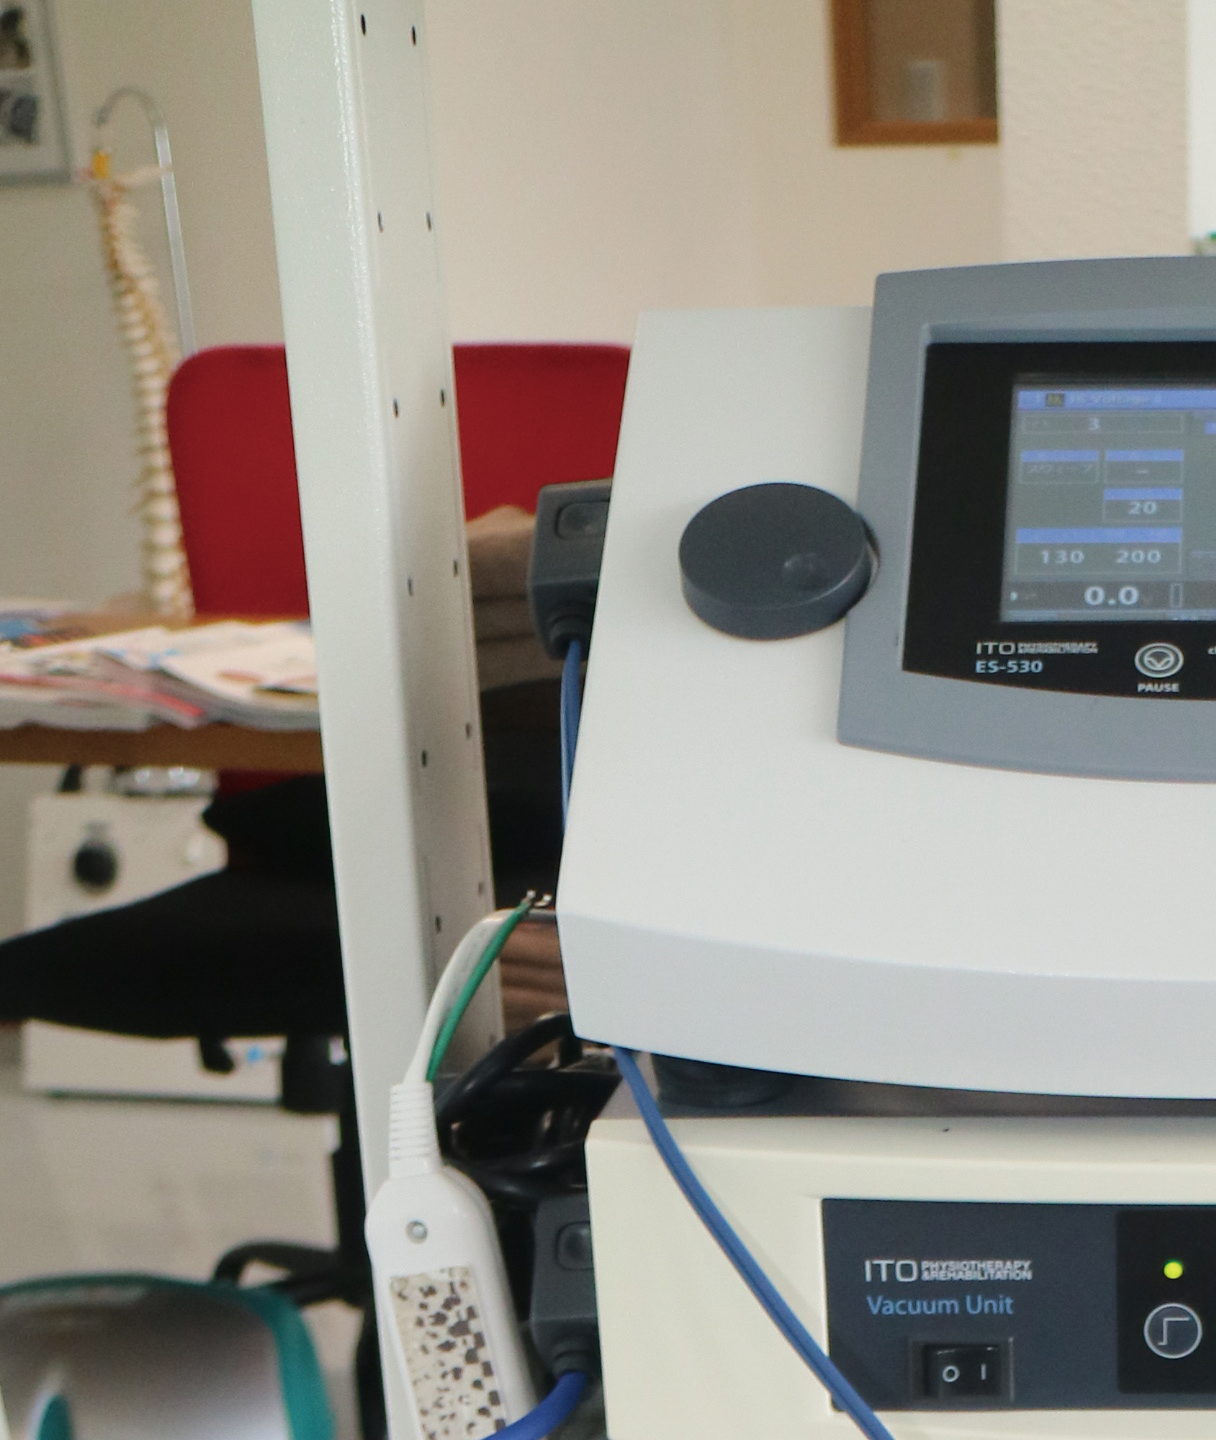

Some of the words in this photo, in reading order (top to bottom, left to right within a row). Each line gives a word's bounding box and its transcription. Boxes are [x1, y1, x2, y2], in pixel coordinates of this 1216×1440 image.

[1128, 501, 1157, 515] 20
[1041, 550, 1085, 564] 130
[1115, 550, 1161, 564] 200
[1084, 586, 1139, 605] 0.0
[976, 641, 1017, 655] ITO
[975, 660, 1043, 674] ES-530
[1137, 683, 1179, 693] PAUSE
[864, 1260, 919, 1282] ITO
[921, 1260, 1032, 1271] PHYSIOTHERAPY
[866, 1295, 959, 1315] Vacuum
[965, 1295, 1015, 1315] Unit
